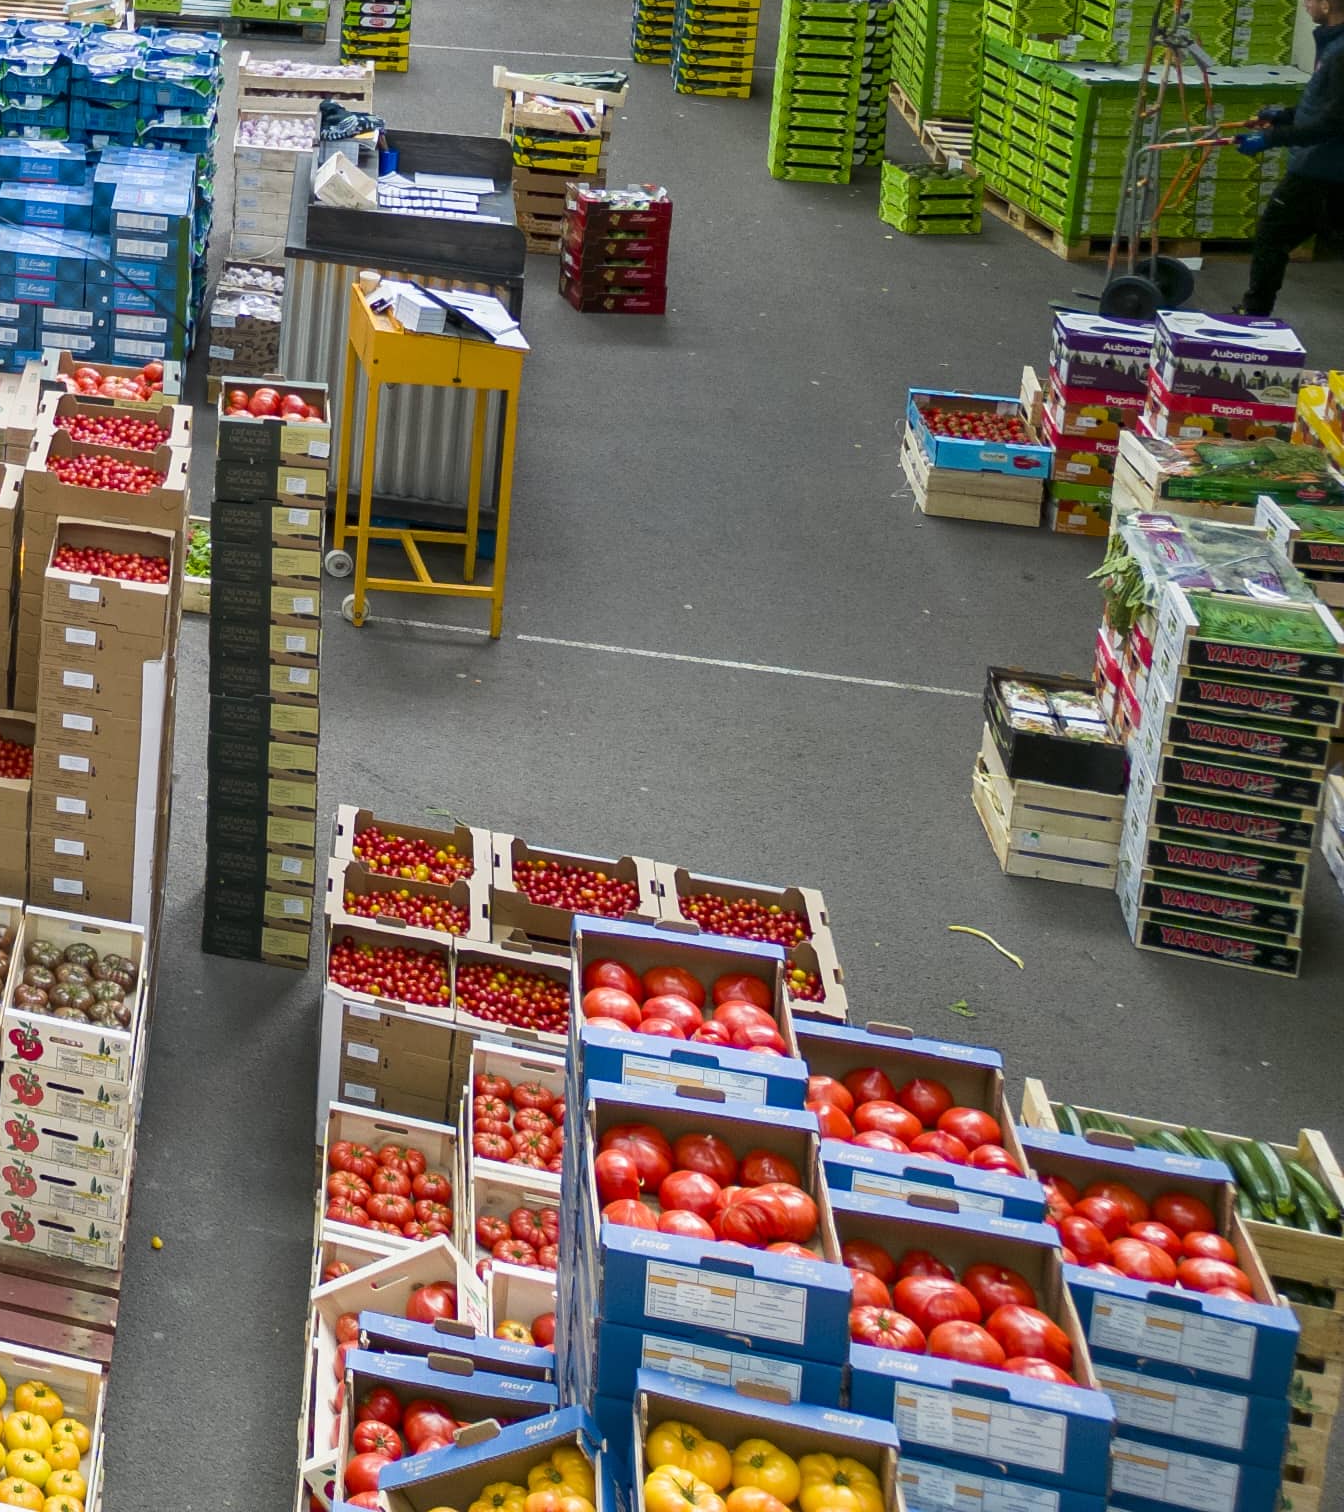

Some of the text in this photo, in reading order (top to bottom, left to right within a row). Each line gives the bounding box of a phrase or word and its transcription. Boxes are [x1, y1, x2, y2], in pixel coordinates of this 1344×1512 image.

[1103, 343, 1153, 355] Aubergin
[1211, 348, 1269, 363] Aubergine
[1211, 403, 1253, 417] Paprika
[1205, 643, 1303, 673] YAKOUTE
[1199, 681, 1295, 711] YAKOUTE
[1186, 722, 1282, 753] YAKOUTE
[1180, 761, 1277, 794] YAKOUTE
[1174, 804, 1280, 839] YAKOUTE
[1164, 844, 1261, 876] YAKOUTE
[1160, 888, 1257, 920] YAKOUTE
[1159, 925, 1257, 961] YAKOUTE
